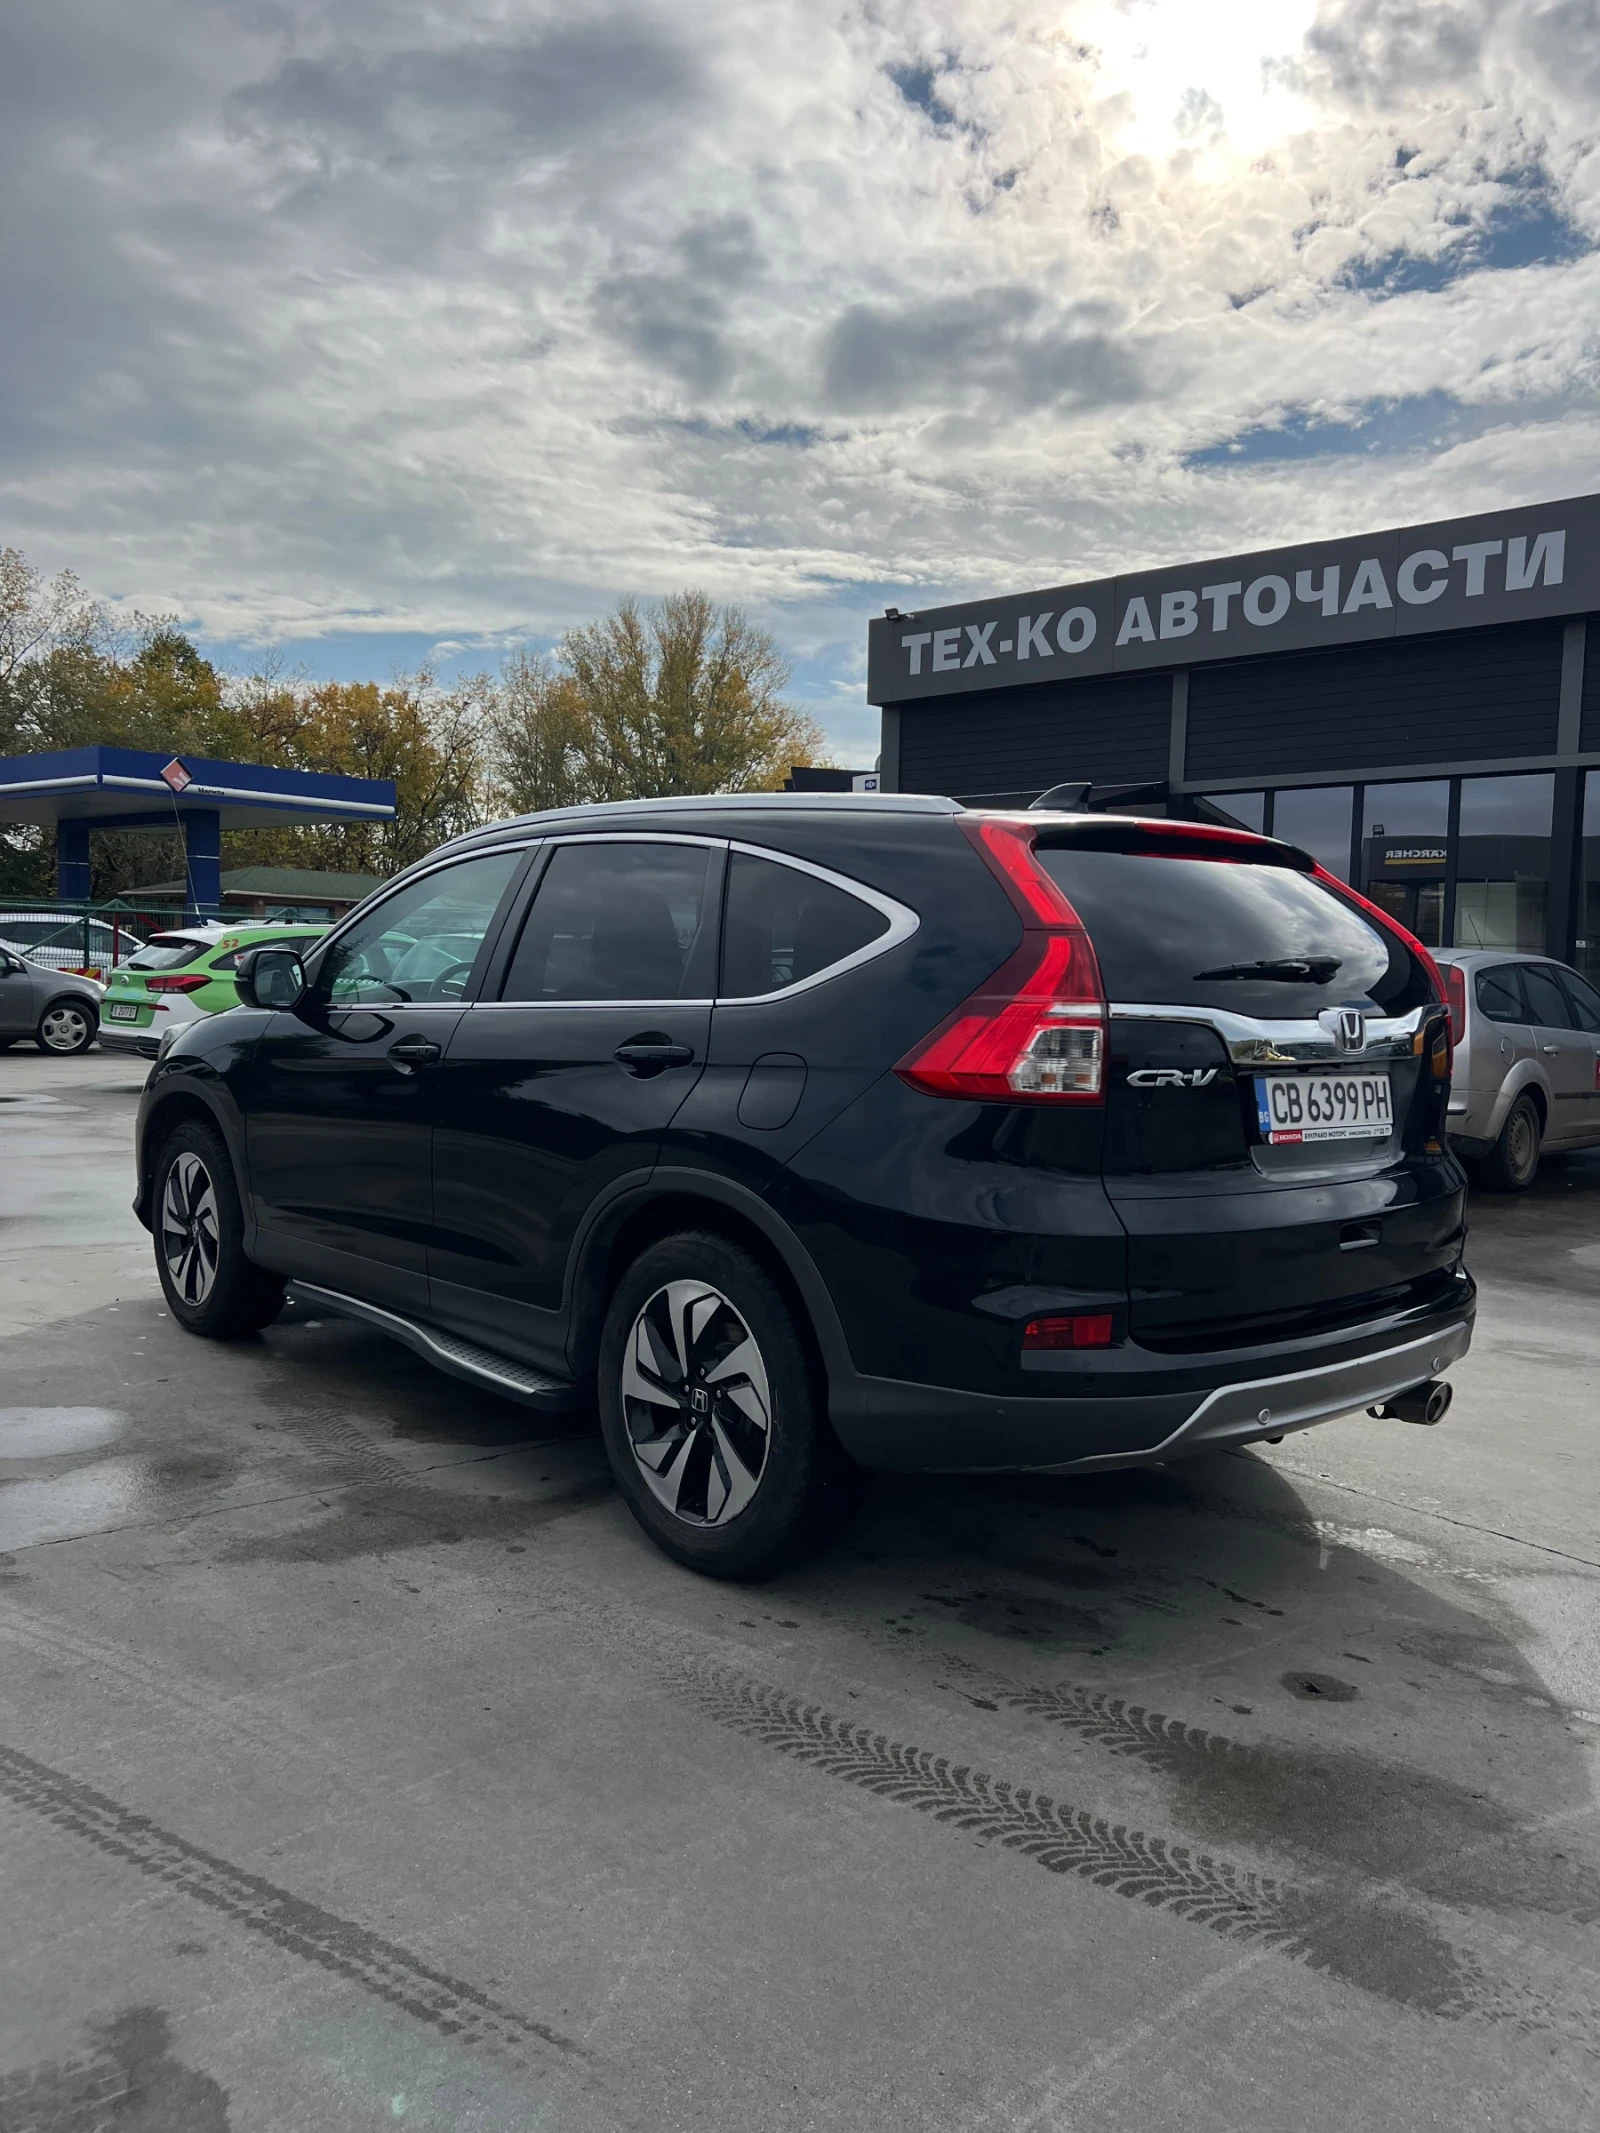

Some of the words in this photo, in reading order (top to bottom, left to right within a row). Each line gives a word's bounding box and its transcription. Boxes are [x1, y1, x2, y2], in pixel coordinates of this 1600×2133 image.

[901, 606, 1097, 675] ТЕХ-КО
[1115, 530, 1566, 647] АВТОЧАСТИ
[222, 938, 239, 949] 52
[1126, 1069, 1218, 1087] CR-V
[1258, 1111, 1270, 1123] BG
[1279, 1132, 1302, 1141] HONDA
